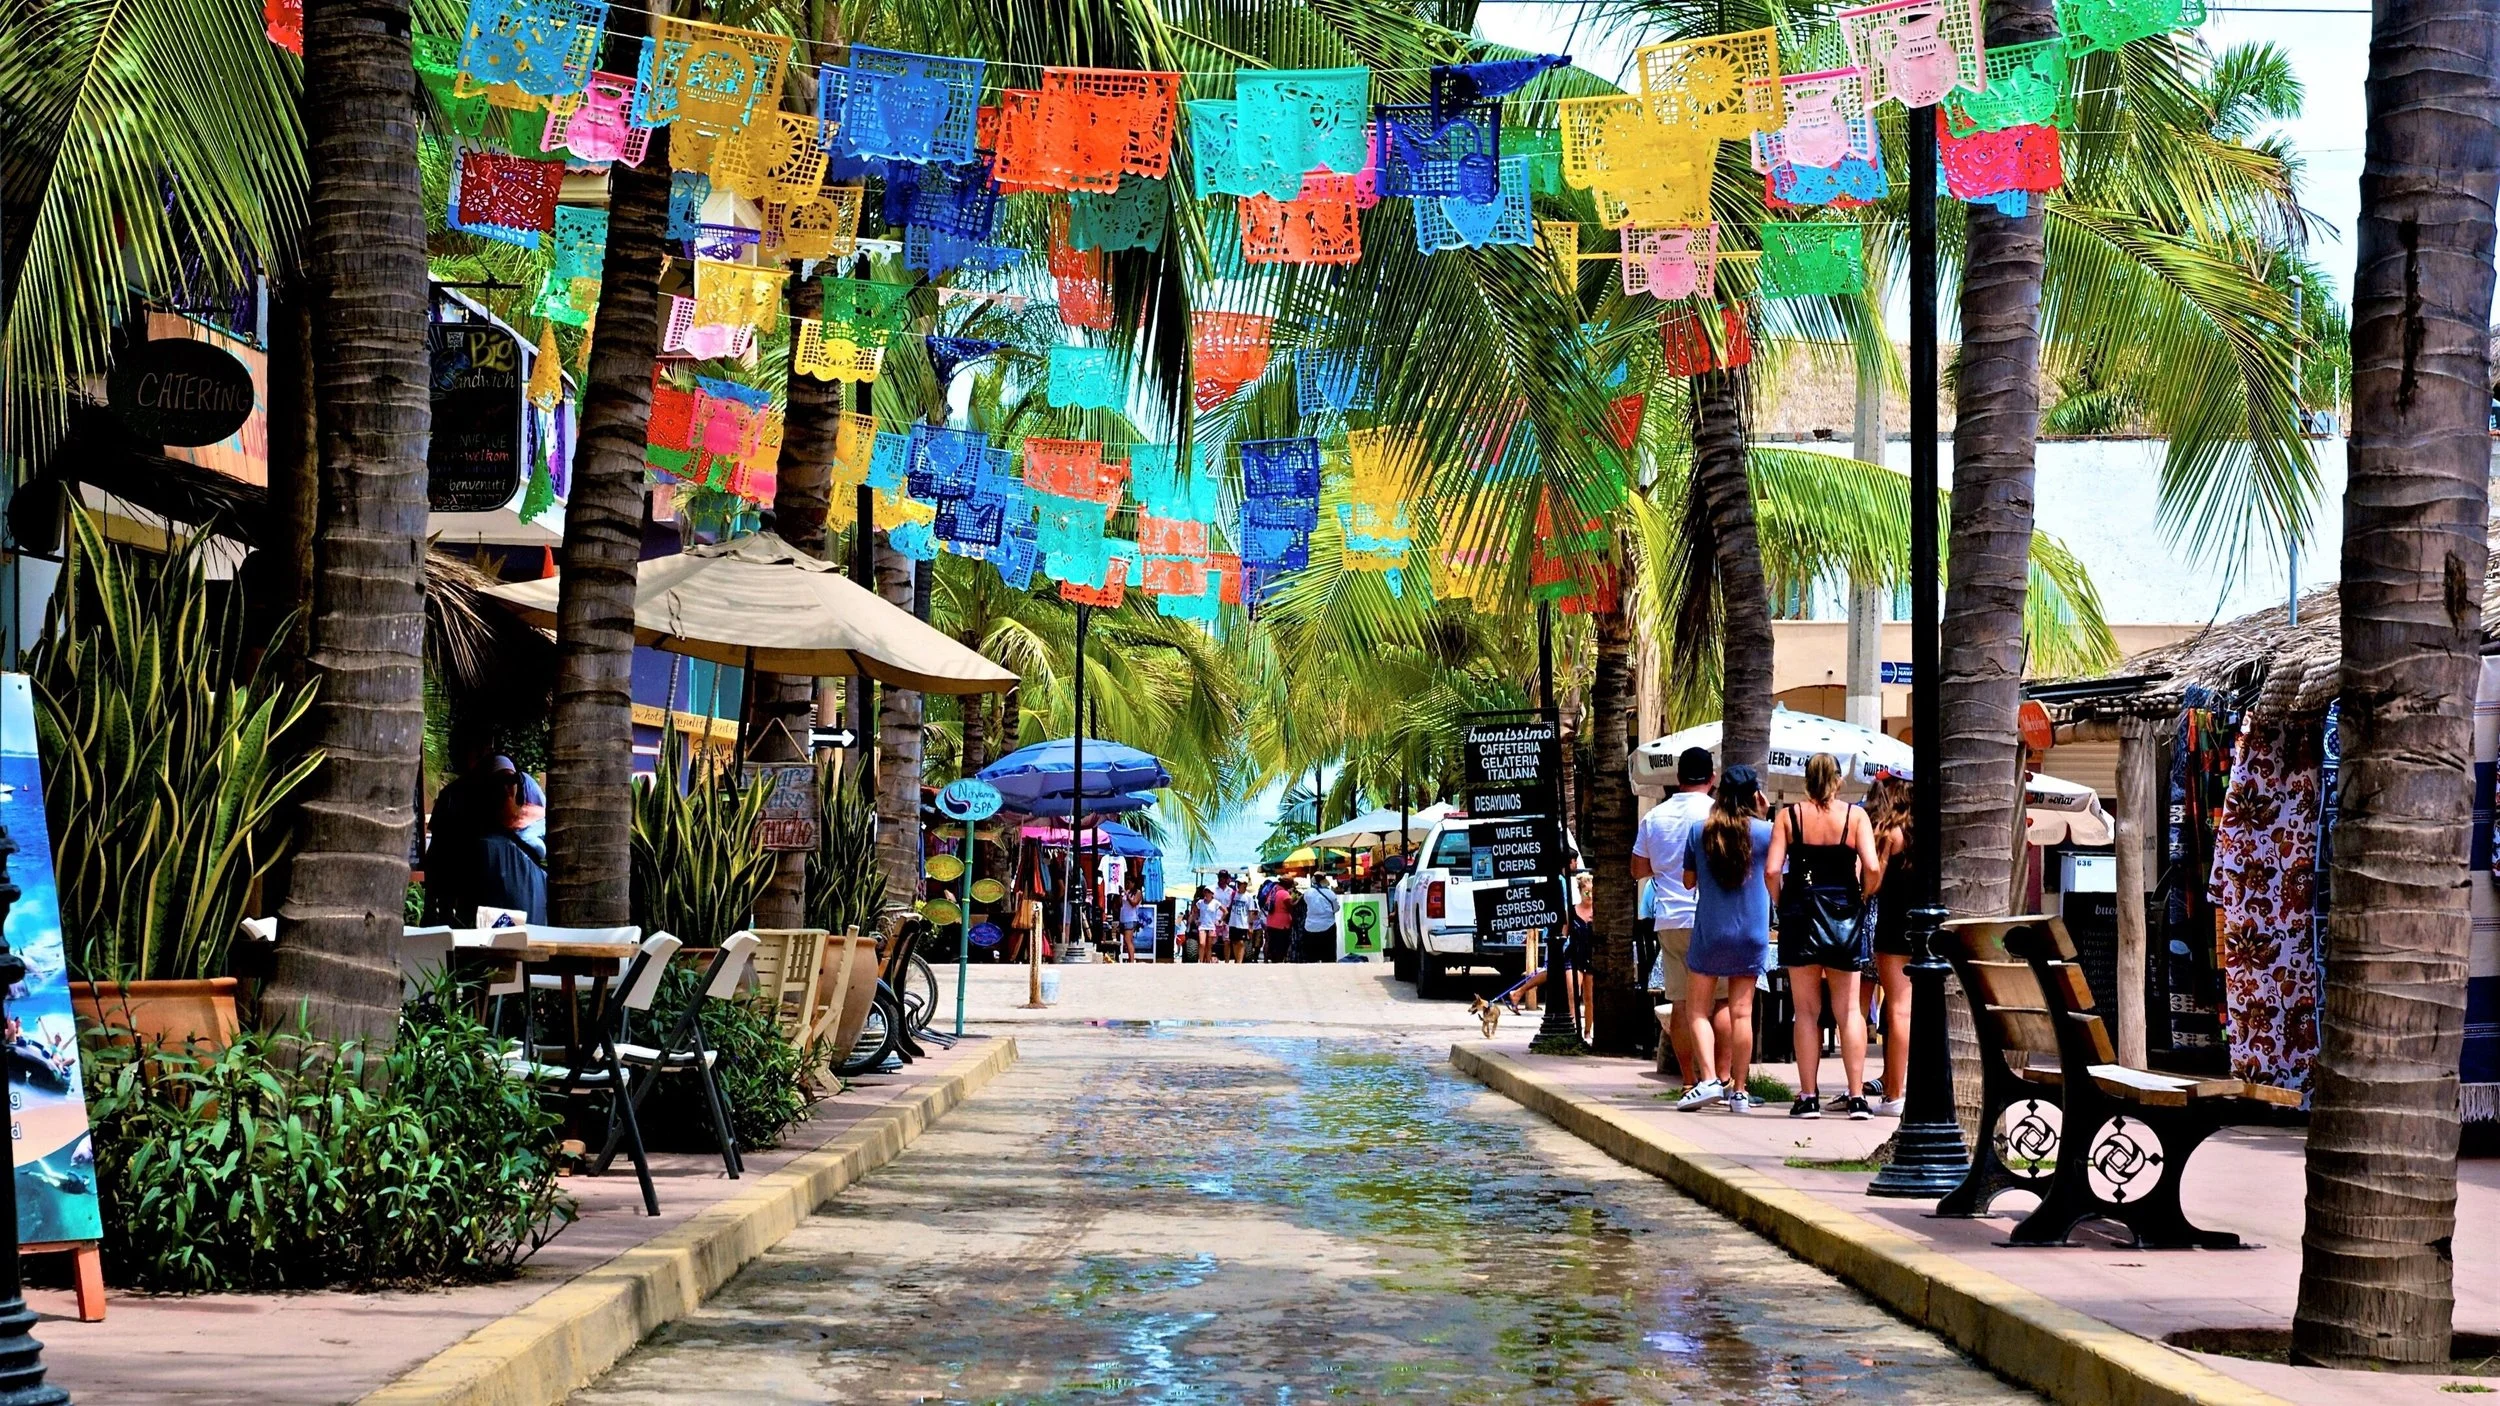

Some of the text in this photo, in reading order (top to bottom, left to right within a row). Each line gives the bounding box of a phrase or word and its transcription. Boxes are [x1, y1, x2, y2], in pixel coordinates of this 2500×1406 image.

[467, 331, 516, 374] Big
[440, 368, 516, 391] Sandwich
[1468, 726, 1552, 743] buonissimo
[1479, 741, 1541, 756] CAFFETERIA
[1481, 754, 1540, 769] GELATERIA
[1648, 753, 1673, 770] QUIERO
[1768, 750, 1791, 767] IERO
[1487, 766, 1538, 781] ITALIANA
[973, 801, 994, 814] SPA
[1474, 793, 1522, 812] DESAYUNOS
[1495, 825, 1533, 840] WAFFLE
[1492, 841, 1541, 856] CUPCAKES
[1499, 858, 1536, 873] CREPAS
[1505, 886, 1531, 901] CAFE
[1496, 899, 1545, 916] ESPRESSO
[1491, 911, 1558, 932] FRAPPUCCINO
